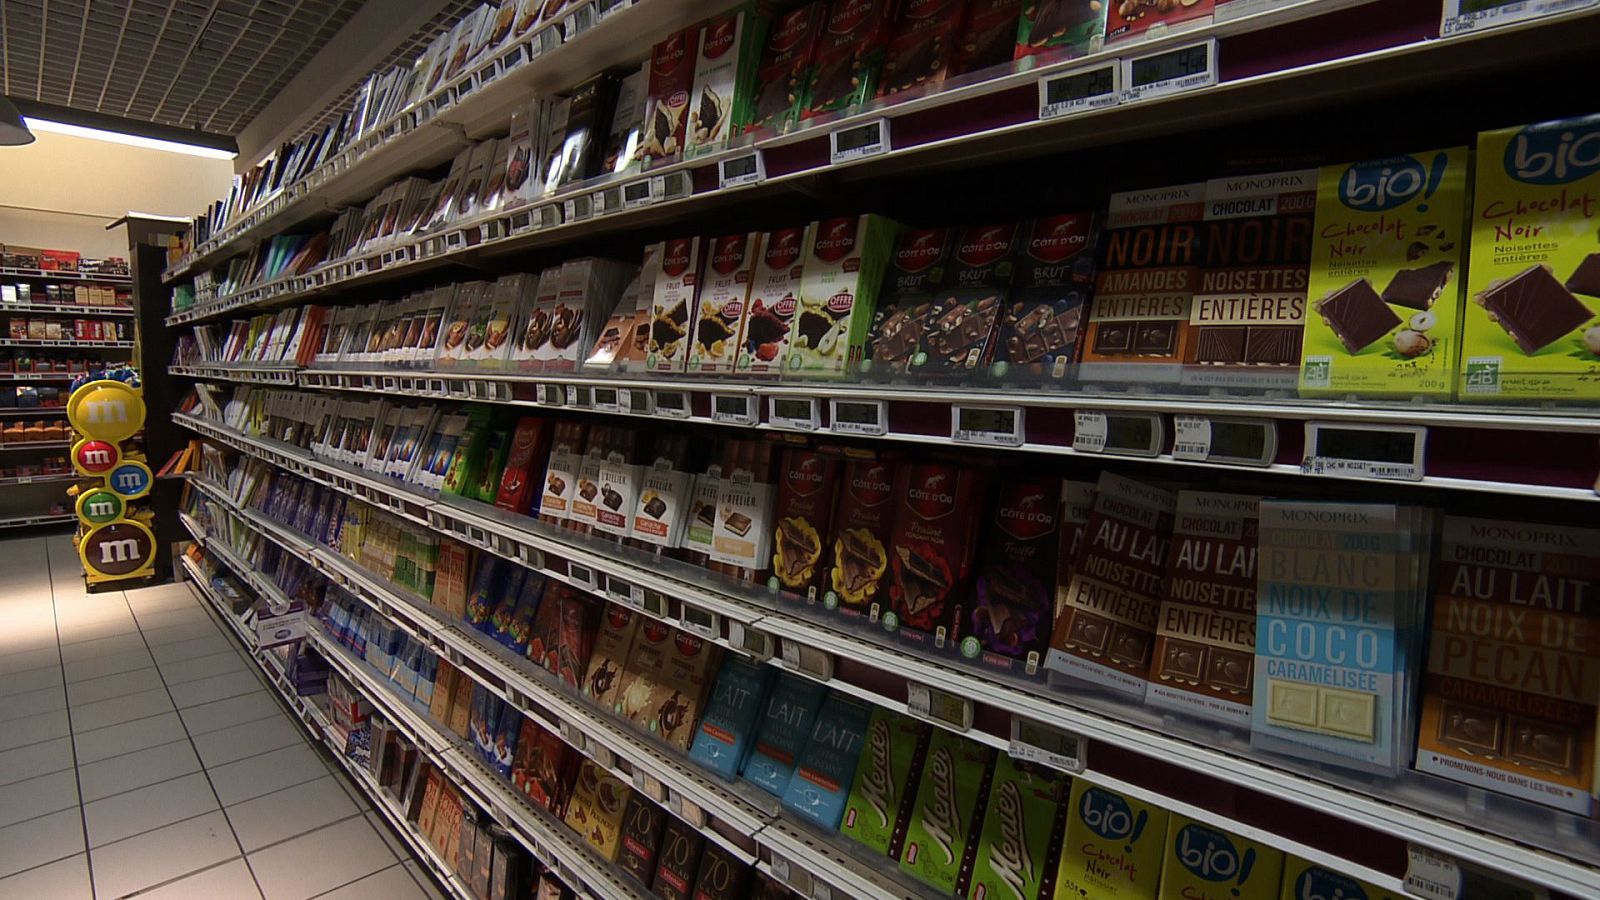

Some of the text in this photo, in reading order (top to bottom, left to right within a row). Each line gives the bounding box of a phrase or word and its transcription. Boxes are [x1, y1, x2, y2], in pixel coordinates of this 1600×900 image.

[1226, 175, 1305, 193] MONOPRIX
[1126, 189, 1191, 206] MONOPRIX
[1212, 198, 1274, 216] CHOCOLAT
[1482, 188, 1597, 219] Chocolat
[1321, 214, 1408, 241] Chocolat
[1495, 218, 1544, 242] Noir
[961, 244, 984, 254] CÔTE
[1032, 238, 1058, 248] CÔTE
[1105, 225, 1195, 268] NOIR
[1206, 217, 1313, 264] NOIR
[1329, 238, 1366, 259] Noir
[1494, 242, 1560, 253] Noisettes
[1328, 258, 1377, 268] Noisettes
[1494, 253, 1549, 264] entières
[768, 274, 787, 284] FRUIT
[897, 274, 927, 288] BRUT
[959, 268, 992, 281] BRUT
[1033, 265, 1072, 279] BRUT
[1102, 269, 1188, 293] AMANDES
[1203, 268, 1306, 292] NOISETTES
[666, 282, 681, 290] FRUIT
[715, 280, 731, 288] FRUIT
[1097, 293, 1184, 317] ENTIÈRES
[1199, 293, 1303, 320] ENTIÈRES
[1419, 380, 1436, 388] 200
[1469, 369, 1496, 385] AB
[86, 400, 128, 423] m
[85, 450, 109, 465] m
[118, 471, 141, 488] m
[721, 493, 756, 507] L'ATELIER
[909, 488, 953, 504] CÔTE D'OR
[1195, 497, 1259, 512] MONOPRI
[90, 501, 114, 516] m
[1000, 507, 1053, 525] CÔTE D'OR
[1103, 499, 1152, 521] CHOCOLAT
[1281, 509, 1368, 524] MONOPRIX
[1182, 517, 1237, 535] CHOCOLAT
[1470, 525, 1577, 546] MONOPRIX
[99, 538, 141, 564] m
[1093, 519, 1168, 567] AU LAI
[1176, 538, 1258, 579] AU LAI
[1455, 545, 1536, 568] CHOCOLAT
[1271, 551, 1378, 588] BLANC
[1171, 576, 1256, 612] NOISETTE
[1451, 565, 1591, 613] AU LAIT
[1076, 580, 1159, 628] ENTIÈRES
[1269, 583, 1378, 625] NOIX DE
[1447, 600, 1588, 653] NOIX DE
[1268, 619, 1378, 669] COCO
[714, 680, 751, 710] LAIT
[767, 697, 808, 728] LAIT
[812, 719, 861, 753] LAIT
[861, 719, 896, 829] Menier
[1440, 758, 1507, 783] PROMENONS-NOUS
[1507, 775, 1529, 788] DANS
[1529, 780, 1545, 792] LES
[922, 745, 963, 865] Menier
[630, 799, 651, 835] 70
[666, 827, 690, 866] 70
[989, 780, 1035, 900] Menier
[704, 851, 730, 891] 70
[1082, 843, 1137, 882] Chocolat
[1086, 860, 1110, 880] Noir
